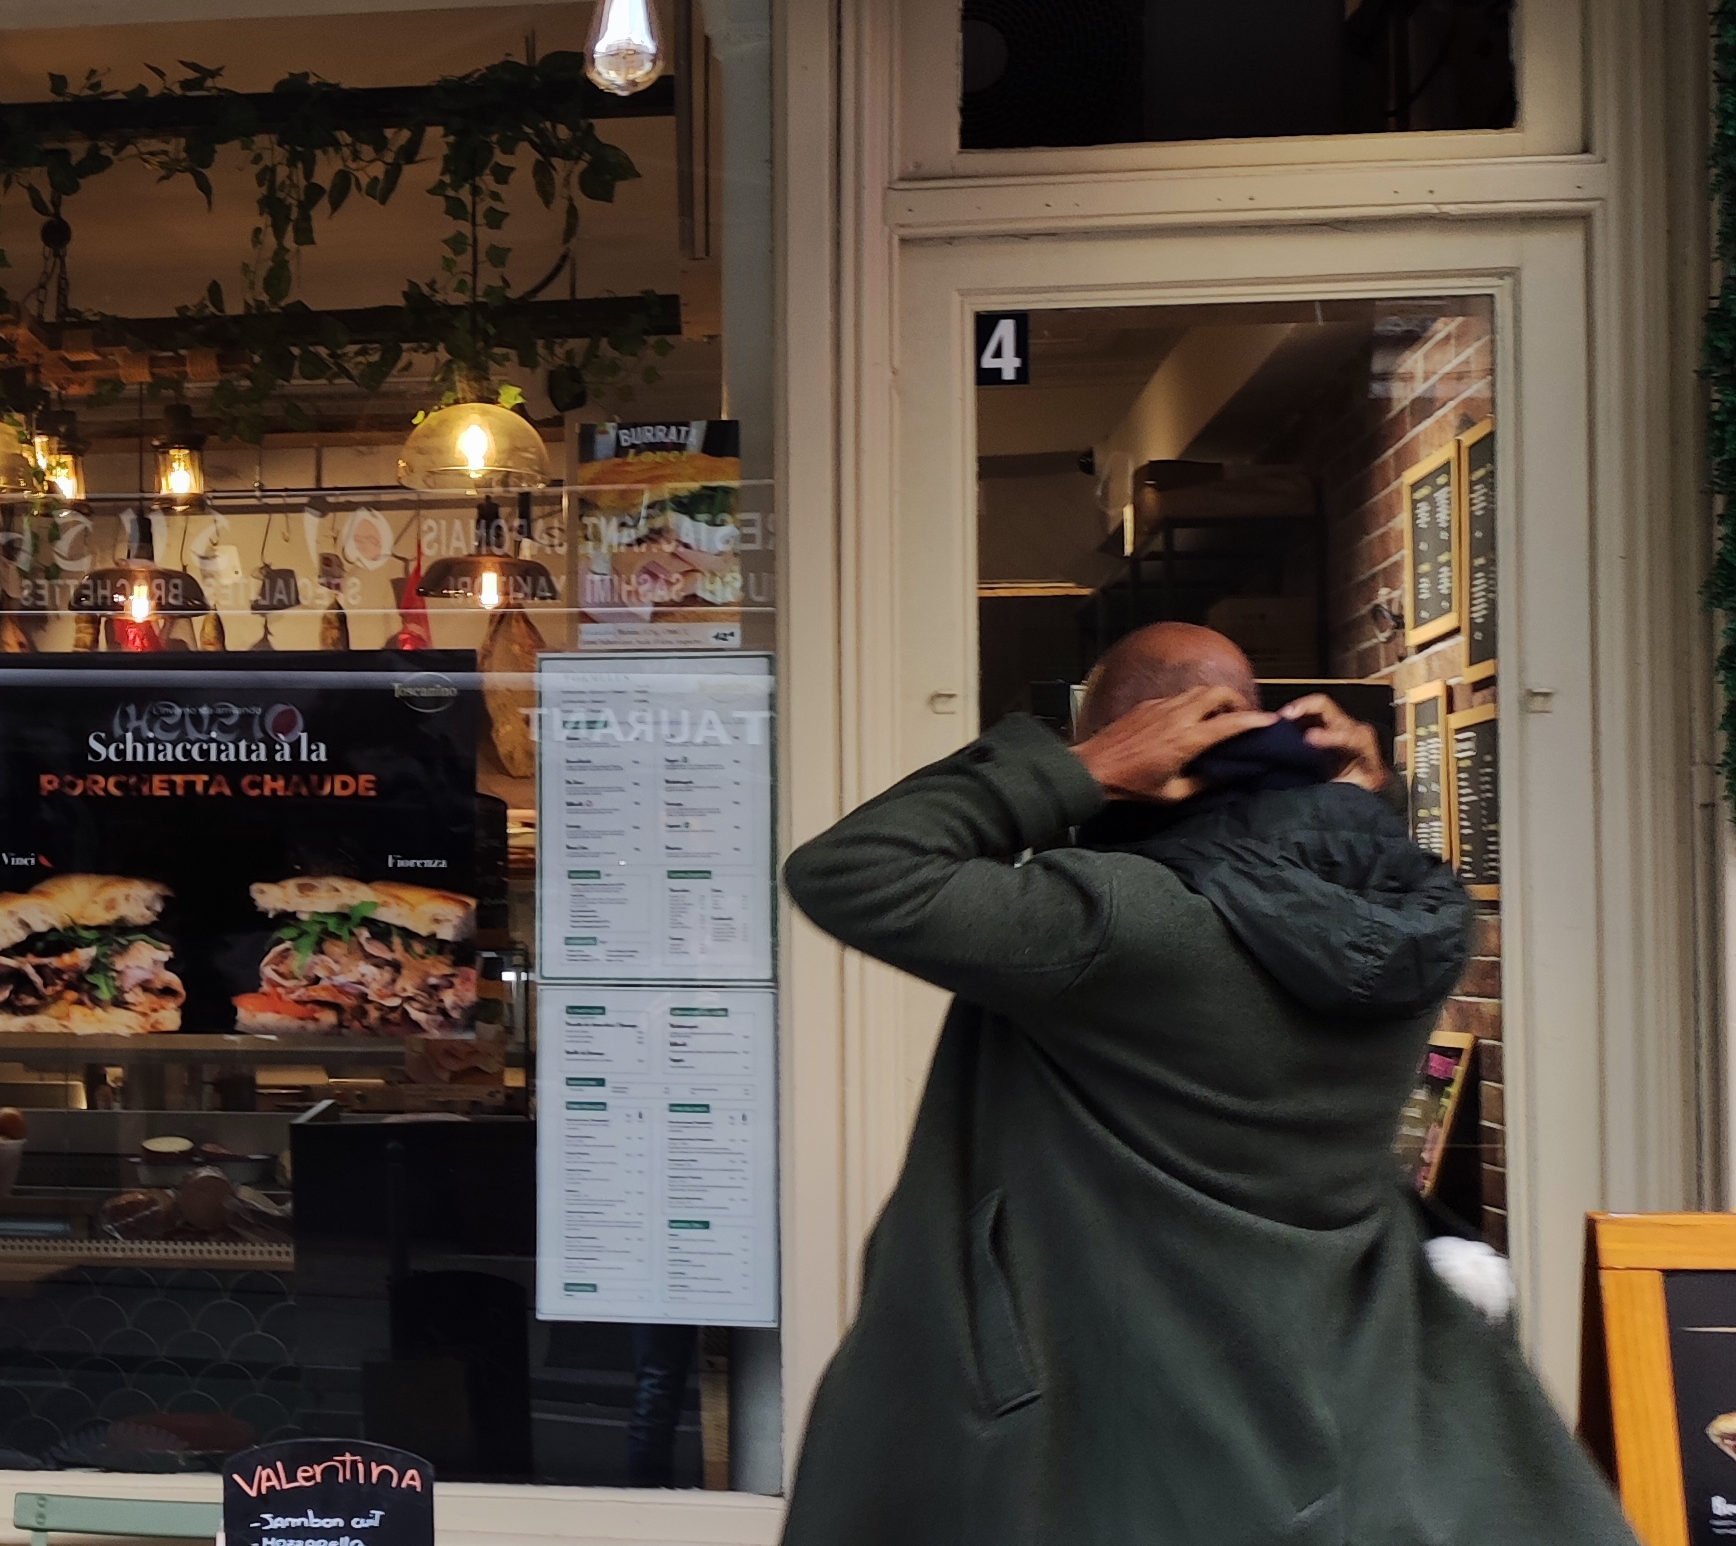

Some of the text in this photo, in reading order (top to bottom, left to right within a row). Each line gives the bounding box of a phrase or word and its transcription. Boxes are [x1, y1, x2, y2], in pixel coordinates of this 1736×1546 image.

[980, 319, 1022, 381] 4
[618, 425, 698, 447] BURRATA
[88, 731, 268, 763] Schiacciata
[299, 731, 328, 763] la
[38, 773, 378, 797] PORCHETTA CHAUDE
